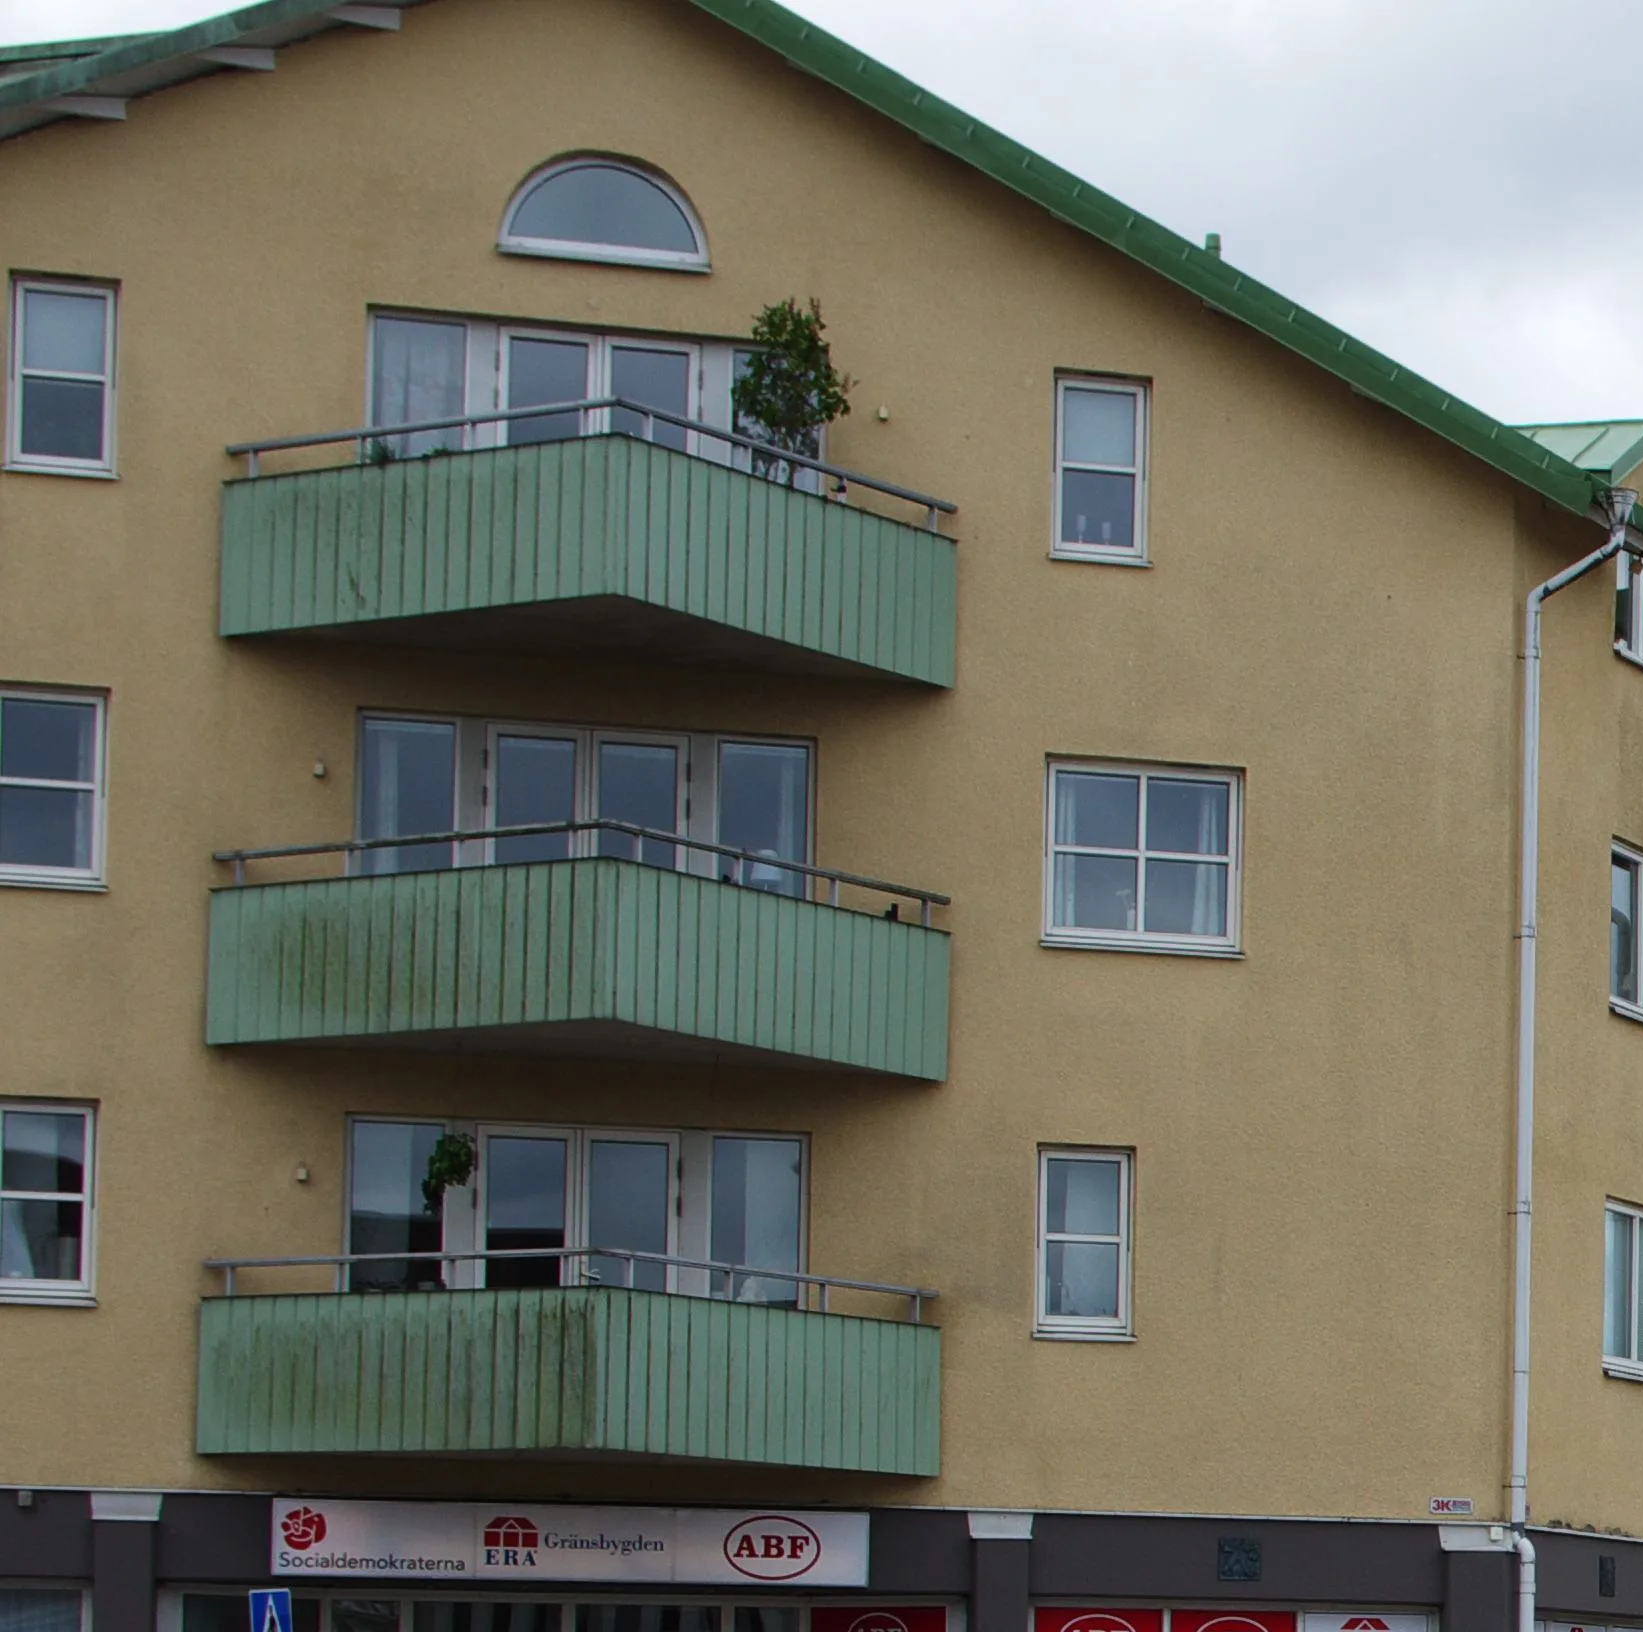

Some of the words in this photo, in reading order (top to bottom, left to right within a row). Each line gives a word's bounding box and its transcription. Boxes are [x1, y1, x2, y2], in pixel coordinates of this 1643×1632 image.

[1431, 1499, 1453, 1512] 3K
[544, 1532, 665, 1556] Gränsbygden
[732, 1534, 810, 1560] ABF
[279, 1551, 466, 1572] Socialdemokraterna
[484, 1549, 537, 1566] ERA
